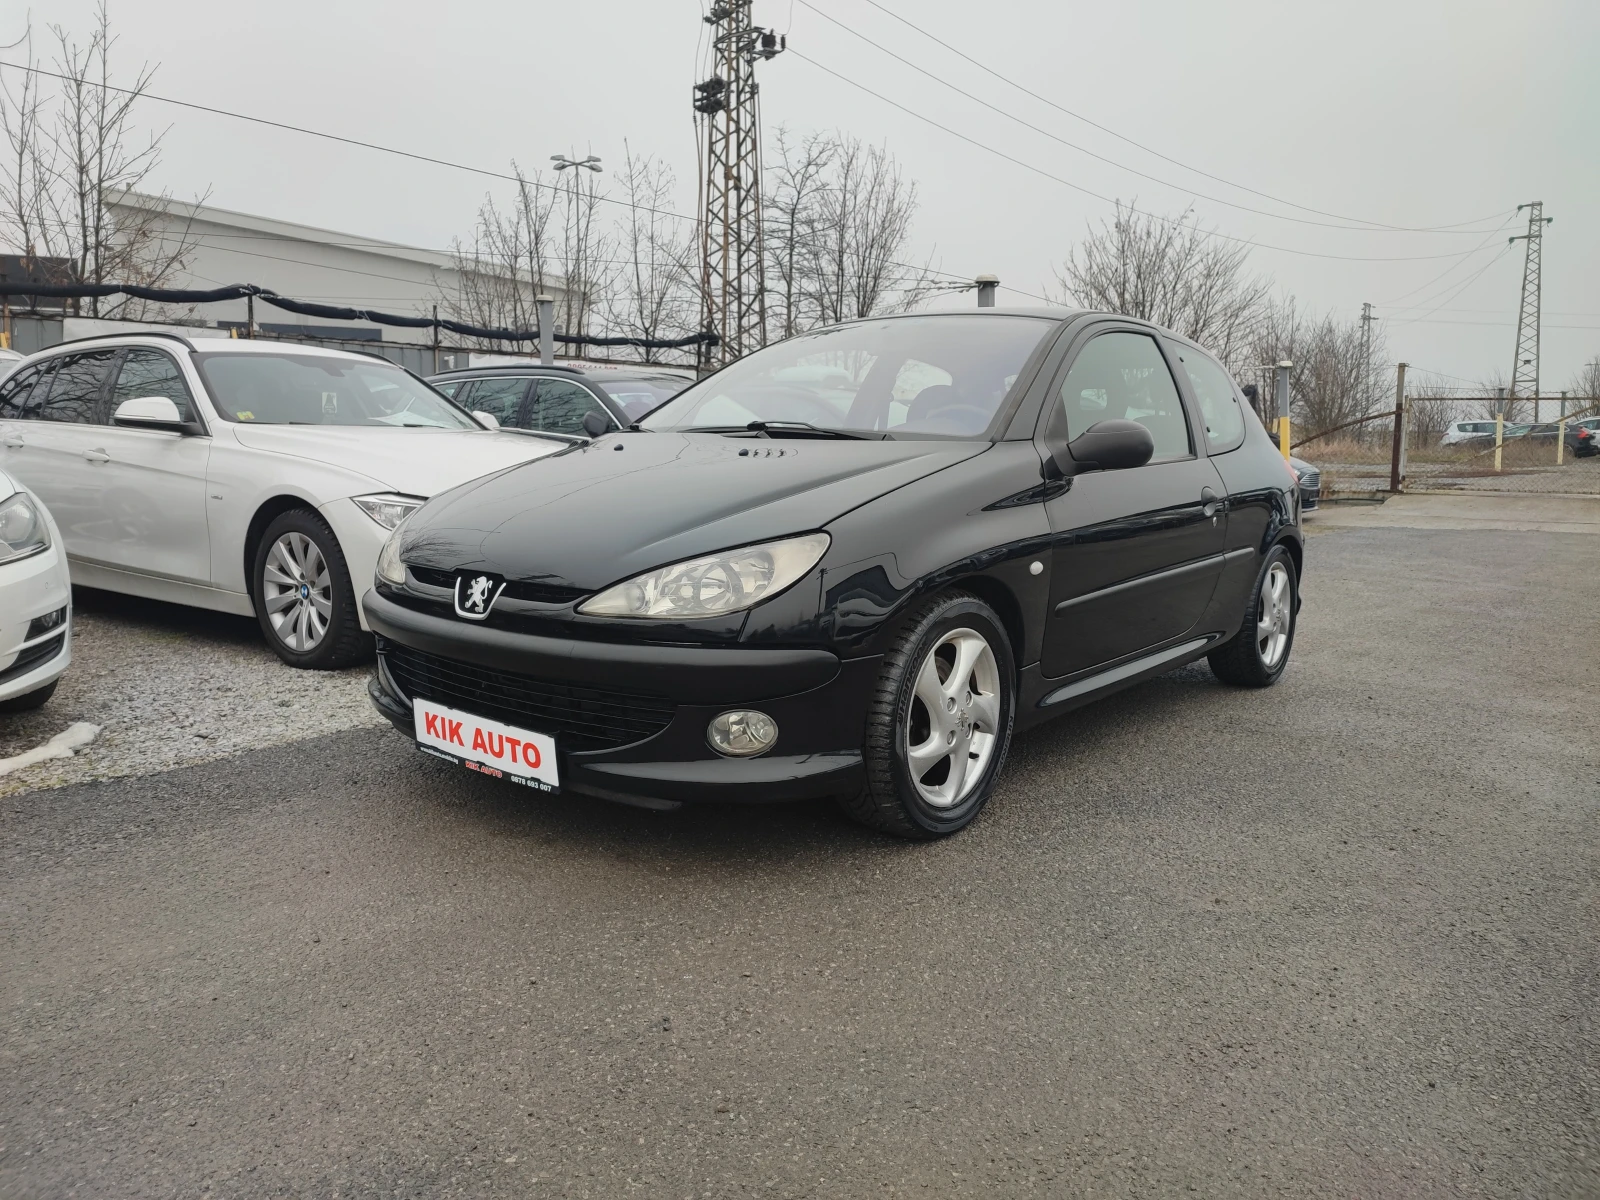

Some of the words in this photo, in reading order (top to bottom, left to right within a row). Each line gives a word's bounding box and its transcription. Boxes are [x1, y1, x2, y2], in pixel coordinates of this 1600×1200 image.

[425, 711, 465, 747] KIK
[472, 727, 541, 769] AUTO
[465, 761, 480, 771] KIK
[481, 766, 502, 778] AUTO
